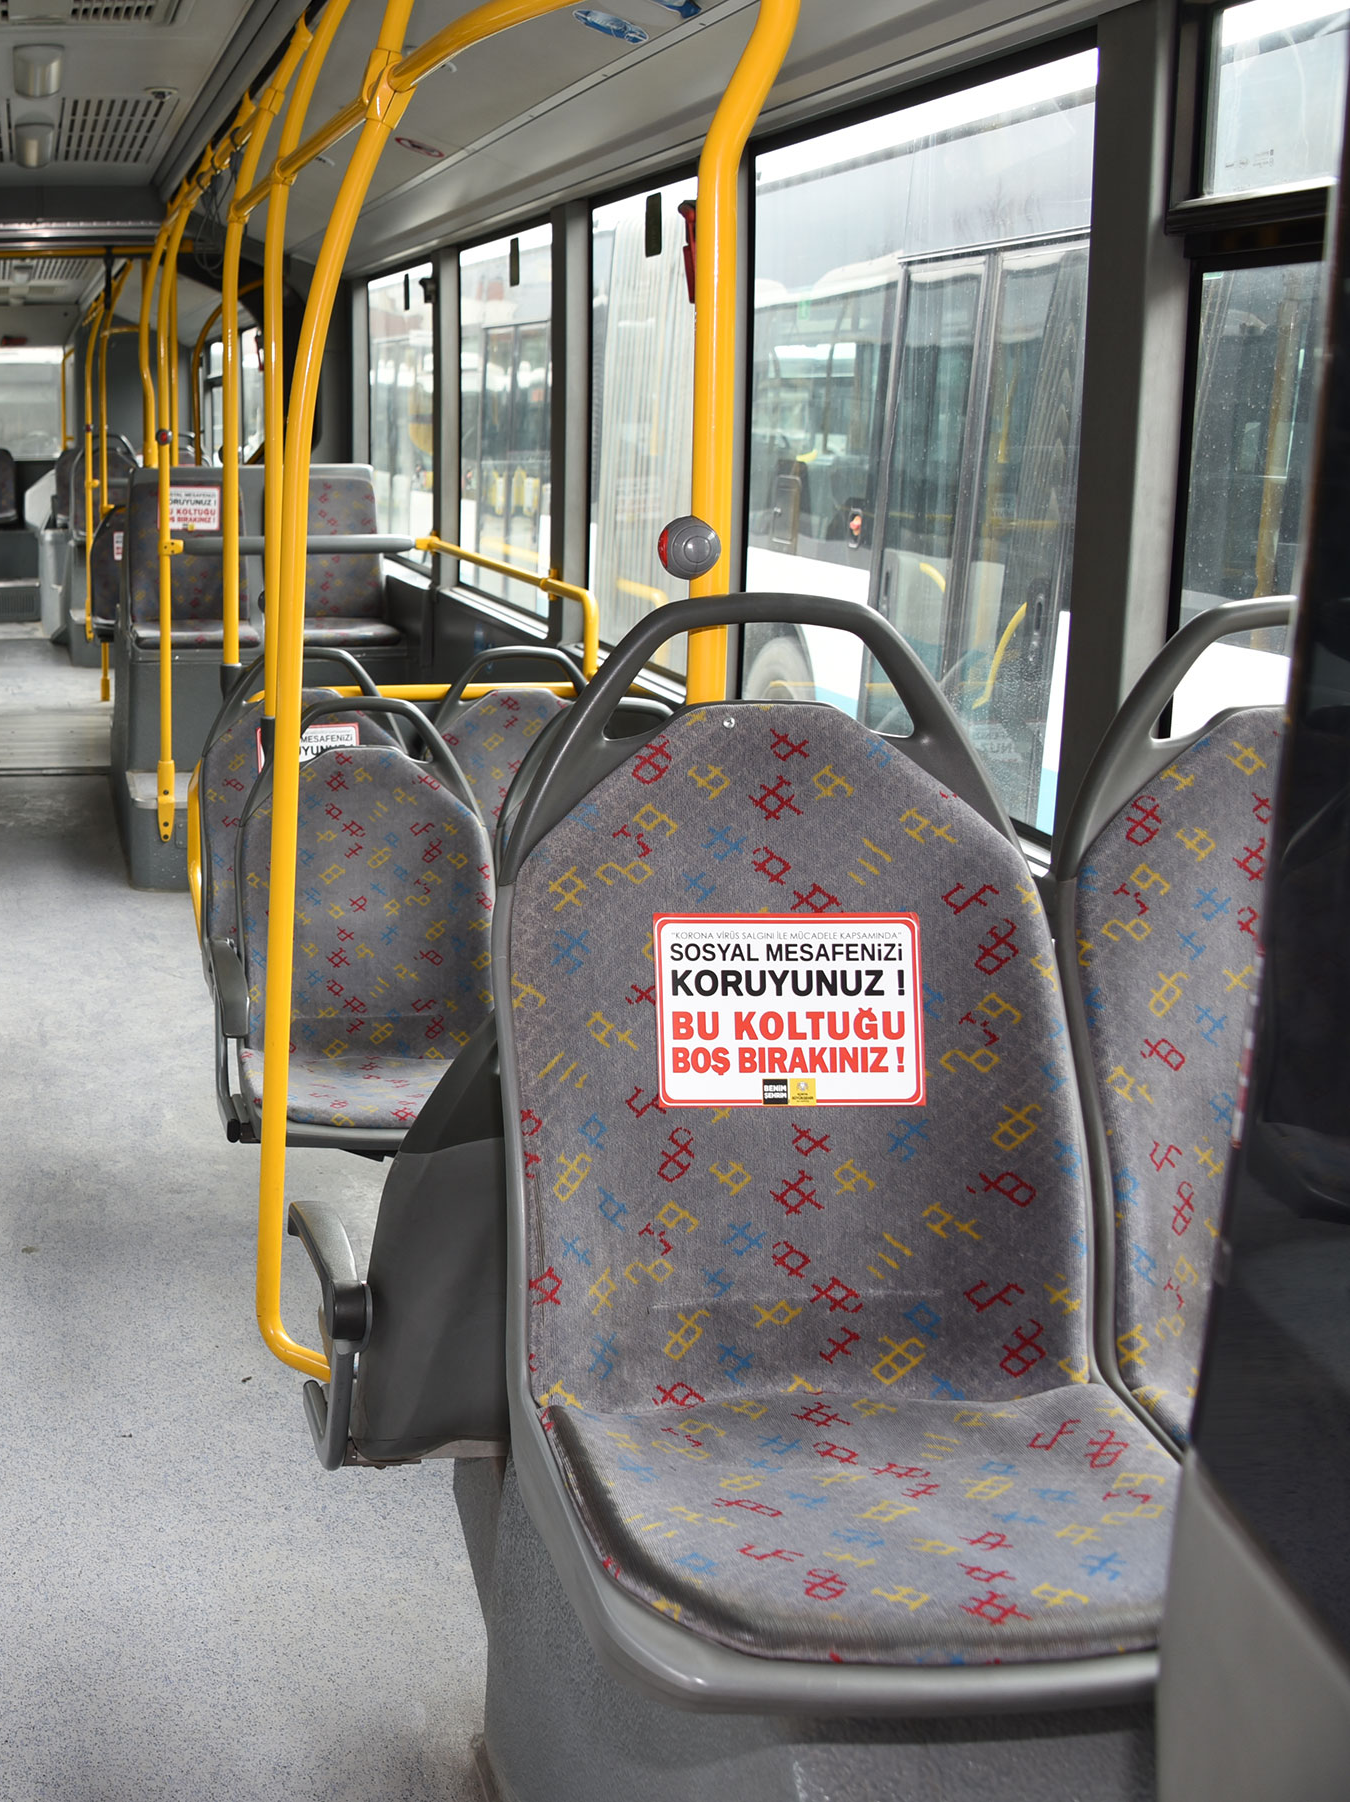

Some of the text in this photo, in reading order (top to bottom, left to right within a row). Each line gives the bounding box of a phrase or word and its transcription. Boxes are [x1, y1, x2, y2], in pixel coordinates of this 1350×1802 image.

[670, 943, 759, 962] SOSYAL
[671, 969, 885, 997] KORUYUNUZ
[671, 1007, 906, 1040] BU KOLTUĞU
[671, 1047, 731, 1076] BOŞ
[738, 1046, 889, 1073] BIRAKINIZ
